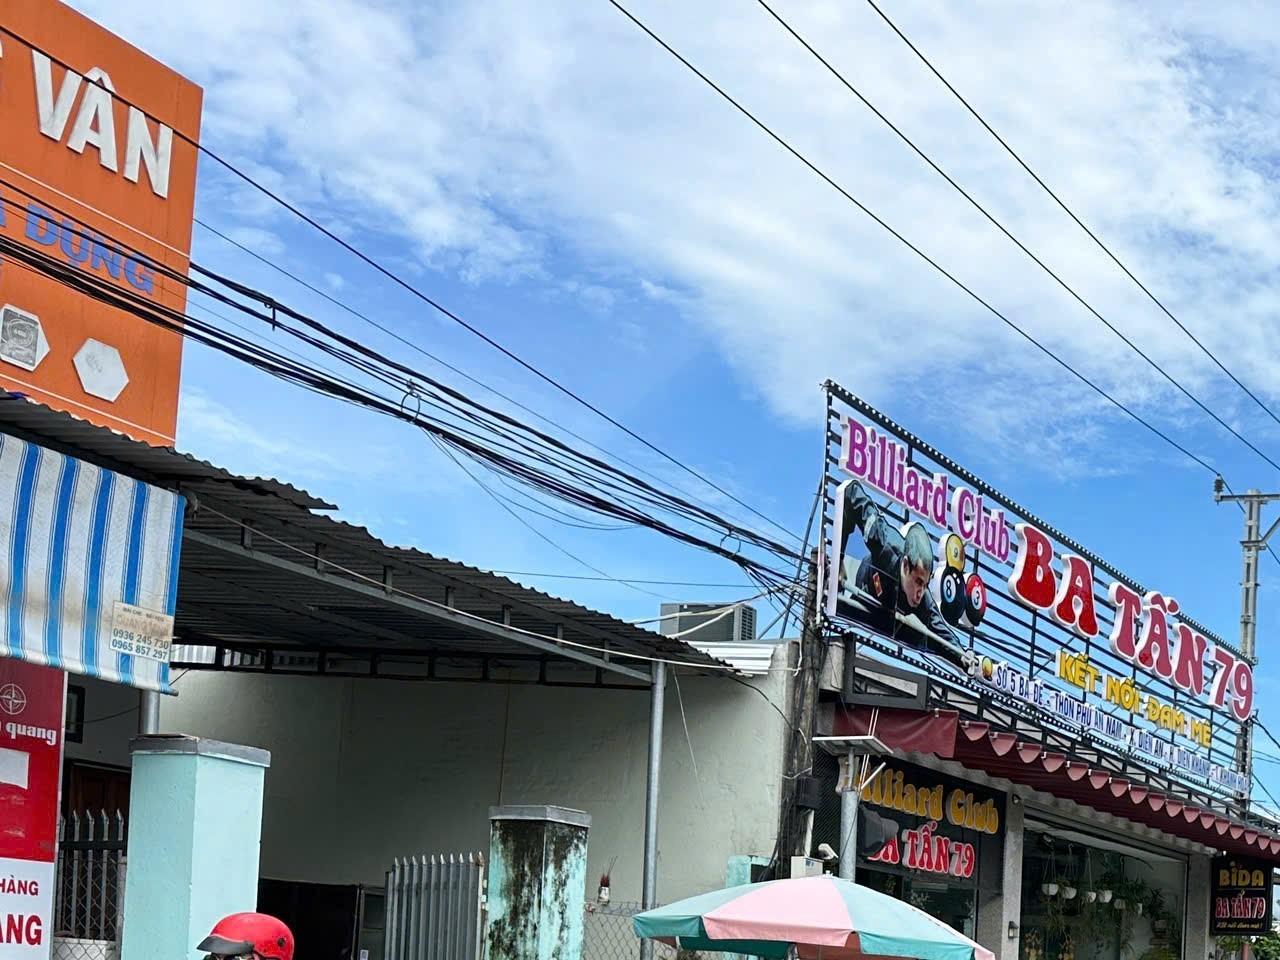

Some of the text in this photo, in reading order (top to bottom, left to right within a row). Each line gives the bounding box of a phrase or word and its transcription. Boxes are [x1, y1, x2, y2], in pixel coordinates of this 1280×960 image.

[32, 49, 174, 200] VÂN
[25, 202, 156, 295] DỤNG
[846, 417, 1010, 562] Billiard Club
[111, 638, 168, 660] 0965 857 297
[112, 628, 134, 641] 0936
[136, 634, 152, 646] 245
[154, 639, 169, 650] 730
[1014, 524, 1253, 720] BA TẤN 79
[1059, 652, 1099, 693] KẾT
[1105, 674, 1141, 714] NỐI
[5, 722, 57, 746] quang
[951, 788, 999, 834] Club
[906, 821, 950, 874] TẤN
[953, 842, 975, 878] 79
[1252, 897, 1266, 918] 79
